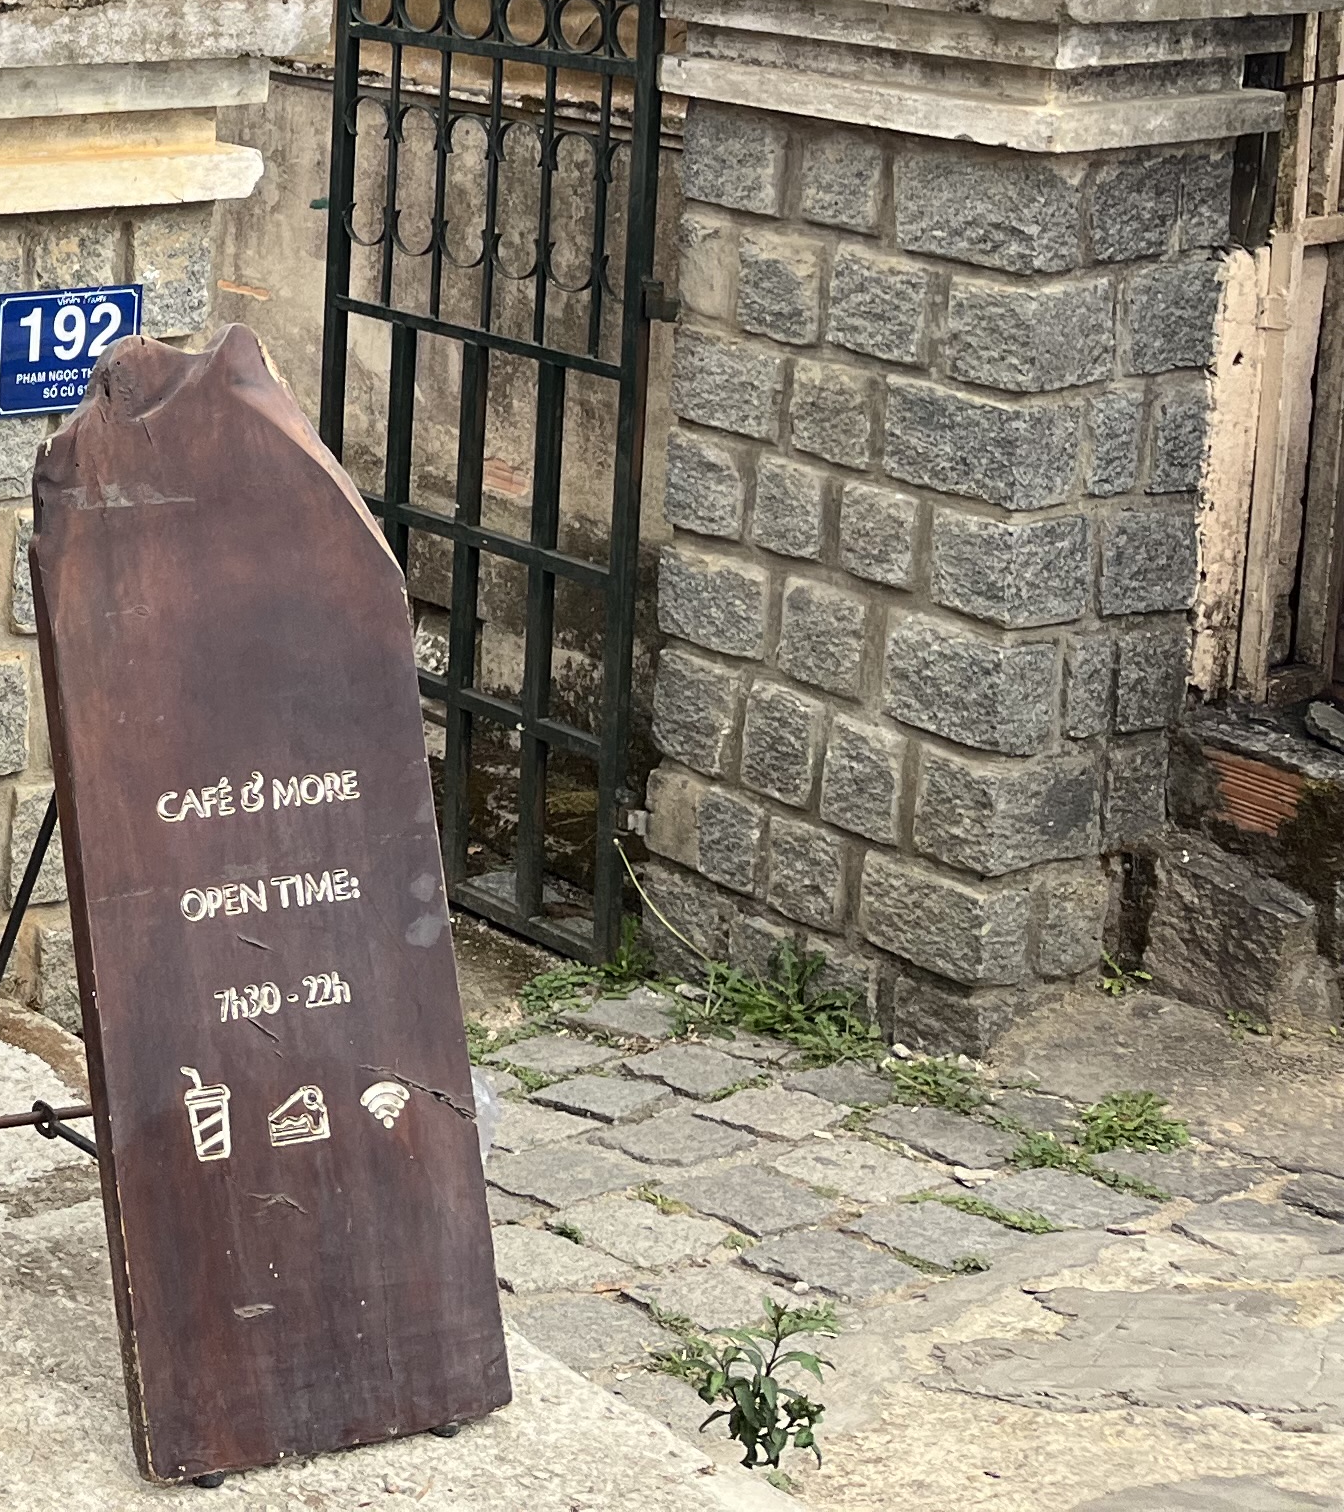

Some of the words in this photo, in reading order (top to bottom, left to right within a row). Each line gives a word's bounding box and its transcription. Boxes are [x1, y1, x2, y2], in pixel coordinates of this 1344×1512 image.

[20, 303, 122, 363] 192
[156, 776, 236, 823] CAFÉ
[272, 770, 361, 810] MORE
[180, 879, 268, 922] OPEN
[270, 868, 362, 909] TIME:
[213, 981, 282, 1023] 7h30
[301, 971, 351, 1009] 22h
